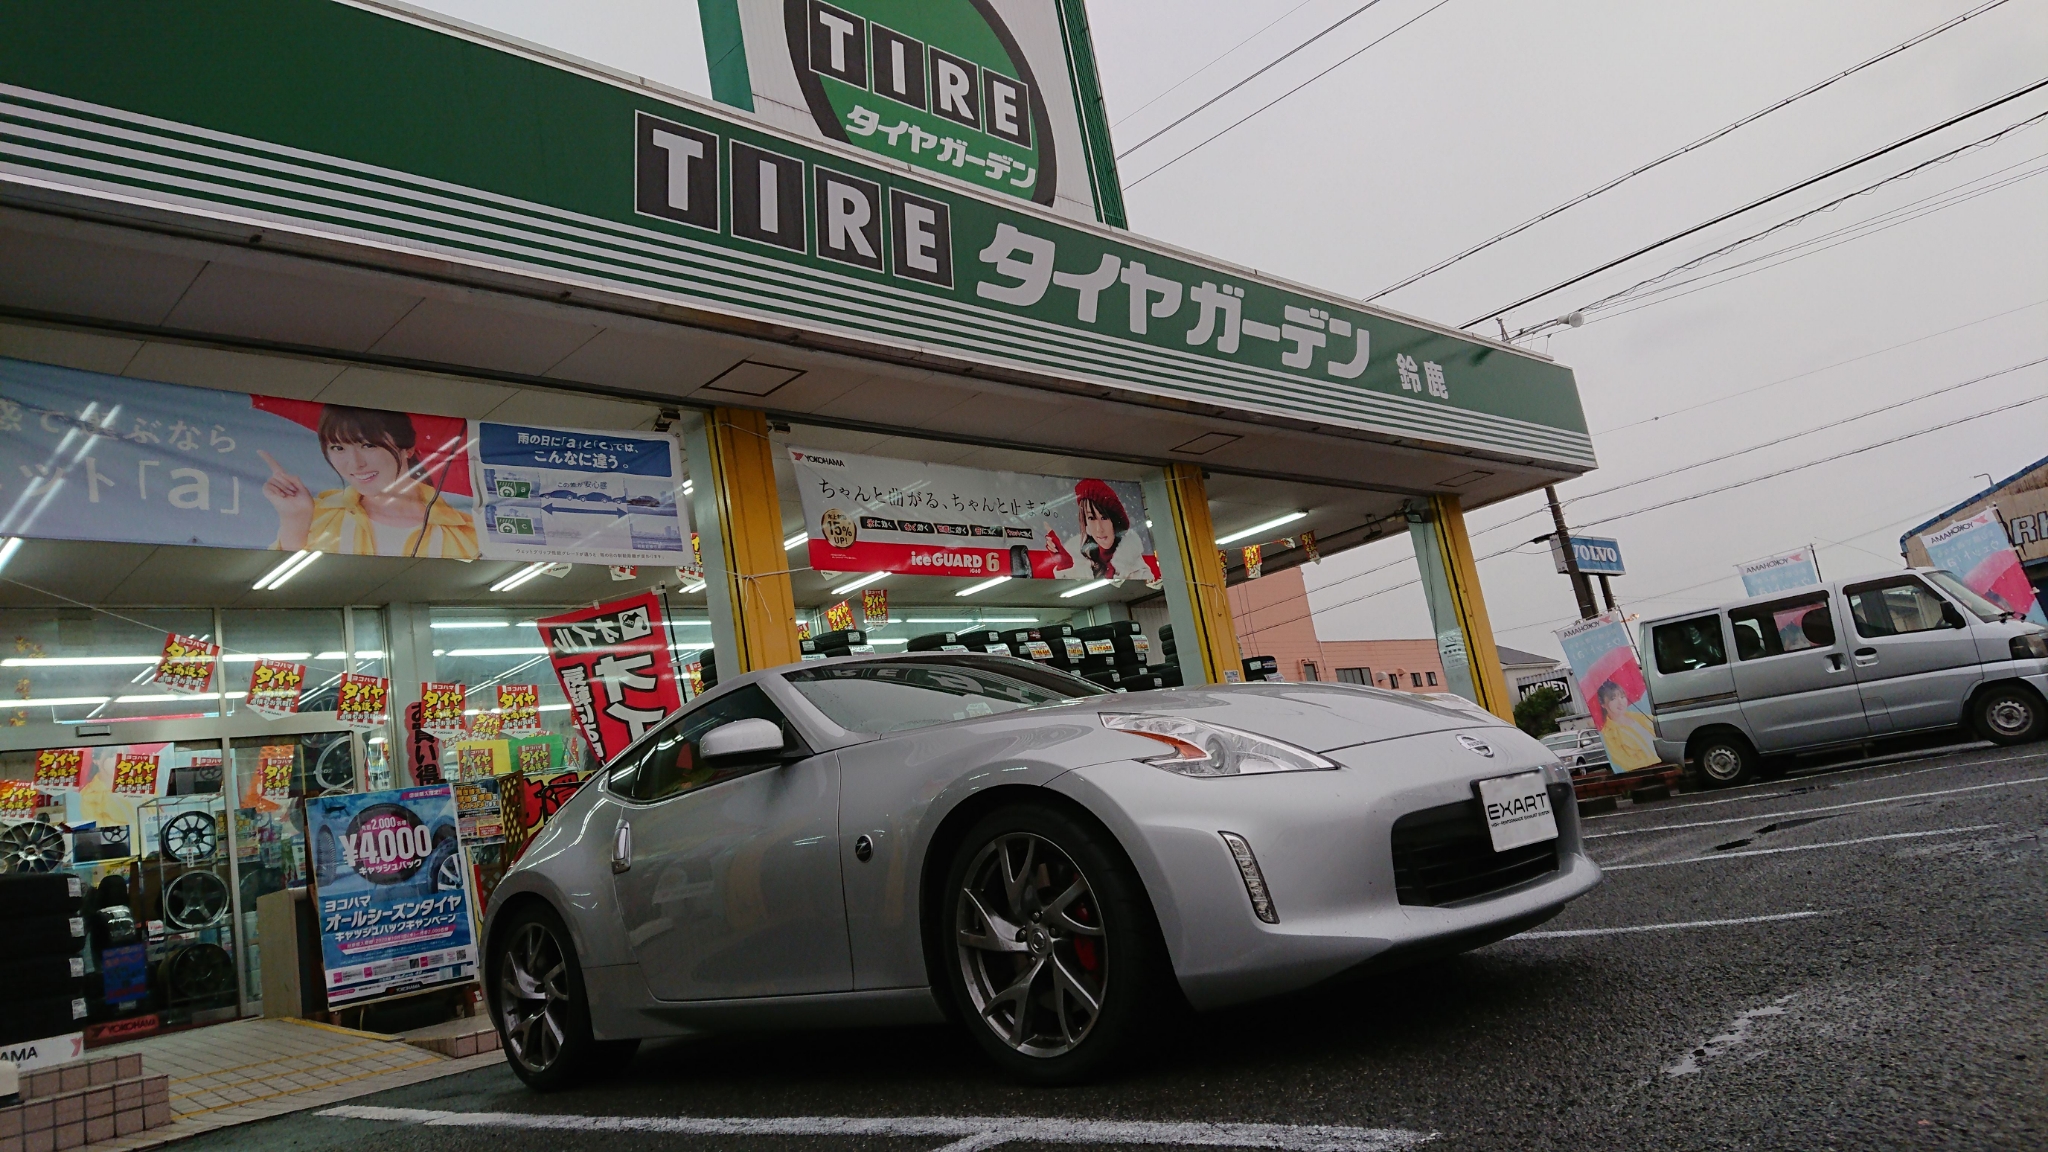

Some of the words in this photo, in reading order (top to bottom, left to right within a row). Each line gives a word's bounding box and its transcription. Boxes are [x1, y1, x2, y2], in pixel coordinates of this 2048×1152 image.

[819, 10, 1019, 136] TIRE
[845, 105, 1037, 189] タイヤガーデン
[652, 128, 939, 273] TIRE
[976, 222, 1370, 380] タイヤガーデン
[1395, 352, 1450, 400] 鈴鹿
[534, 450, 630, 470] こんなに違う。
[804, 455, 846, 468] YOKOHAMA
[819, 479, 1059, 519] ちゃんと曲がる、ちゃんと止まる。
[827, 521, 853, 536] 15%
[834, 537, 849, 545] UP!
[911, 550, 983, 568] iceGUARD
[985, 552, 1000, 572] 6
[864, 595, 886, 608] タイヤ
[827, 605, 850, 623] タイヤ
[166, 641, 213, 666] タイヤ
[255, 664, 301, 687] タイヤ
[341, 681, 385, 700] タイヤ
[423, 690, 463, 708] タイヤ
[499, 692, 537, 709] タイヤ
[39, 750, 81, 768] タイヤ
[520, 750, 549, 764] タイヤ
[116, 760, 156, 775] タイヤ
[1487, 792, 1547, 821] EXART
[339, 825, 433, 868] ¥4,000
[358, 858, 422, 876] キャッシュバック
[324, 895, 371, 913] ヨコハマ
[325, 895, 462, 932] オールシーズンタイヤ
[107, 1018, 157, 1034] YOKOHAMA
